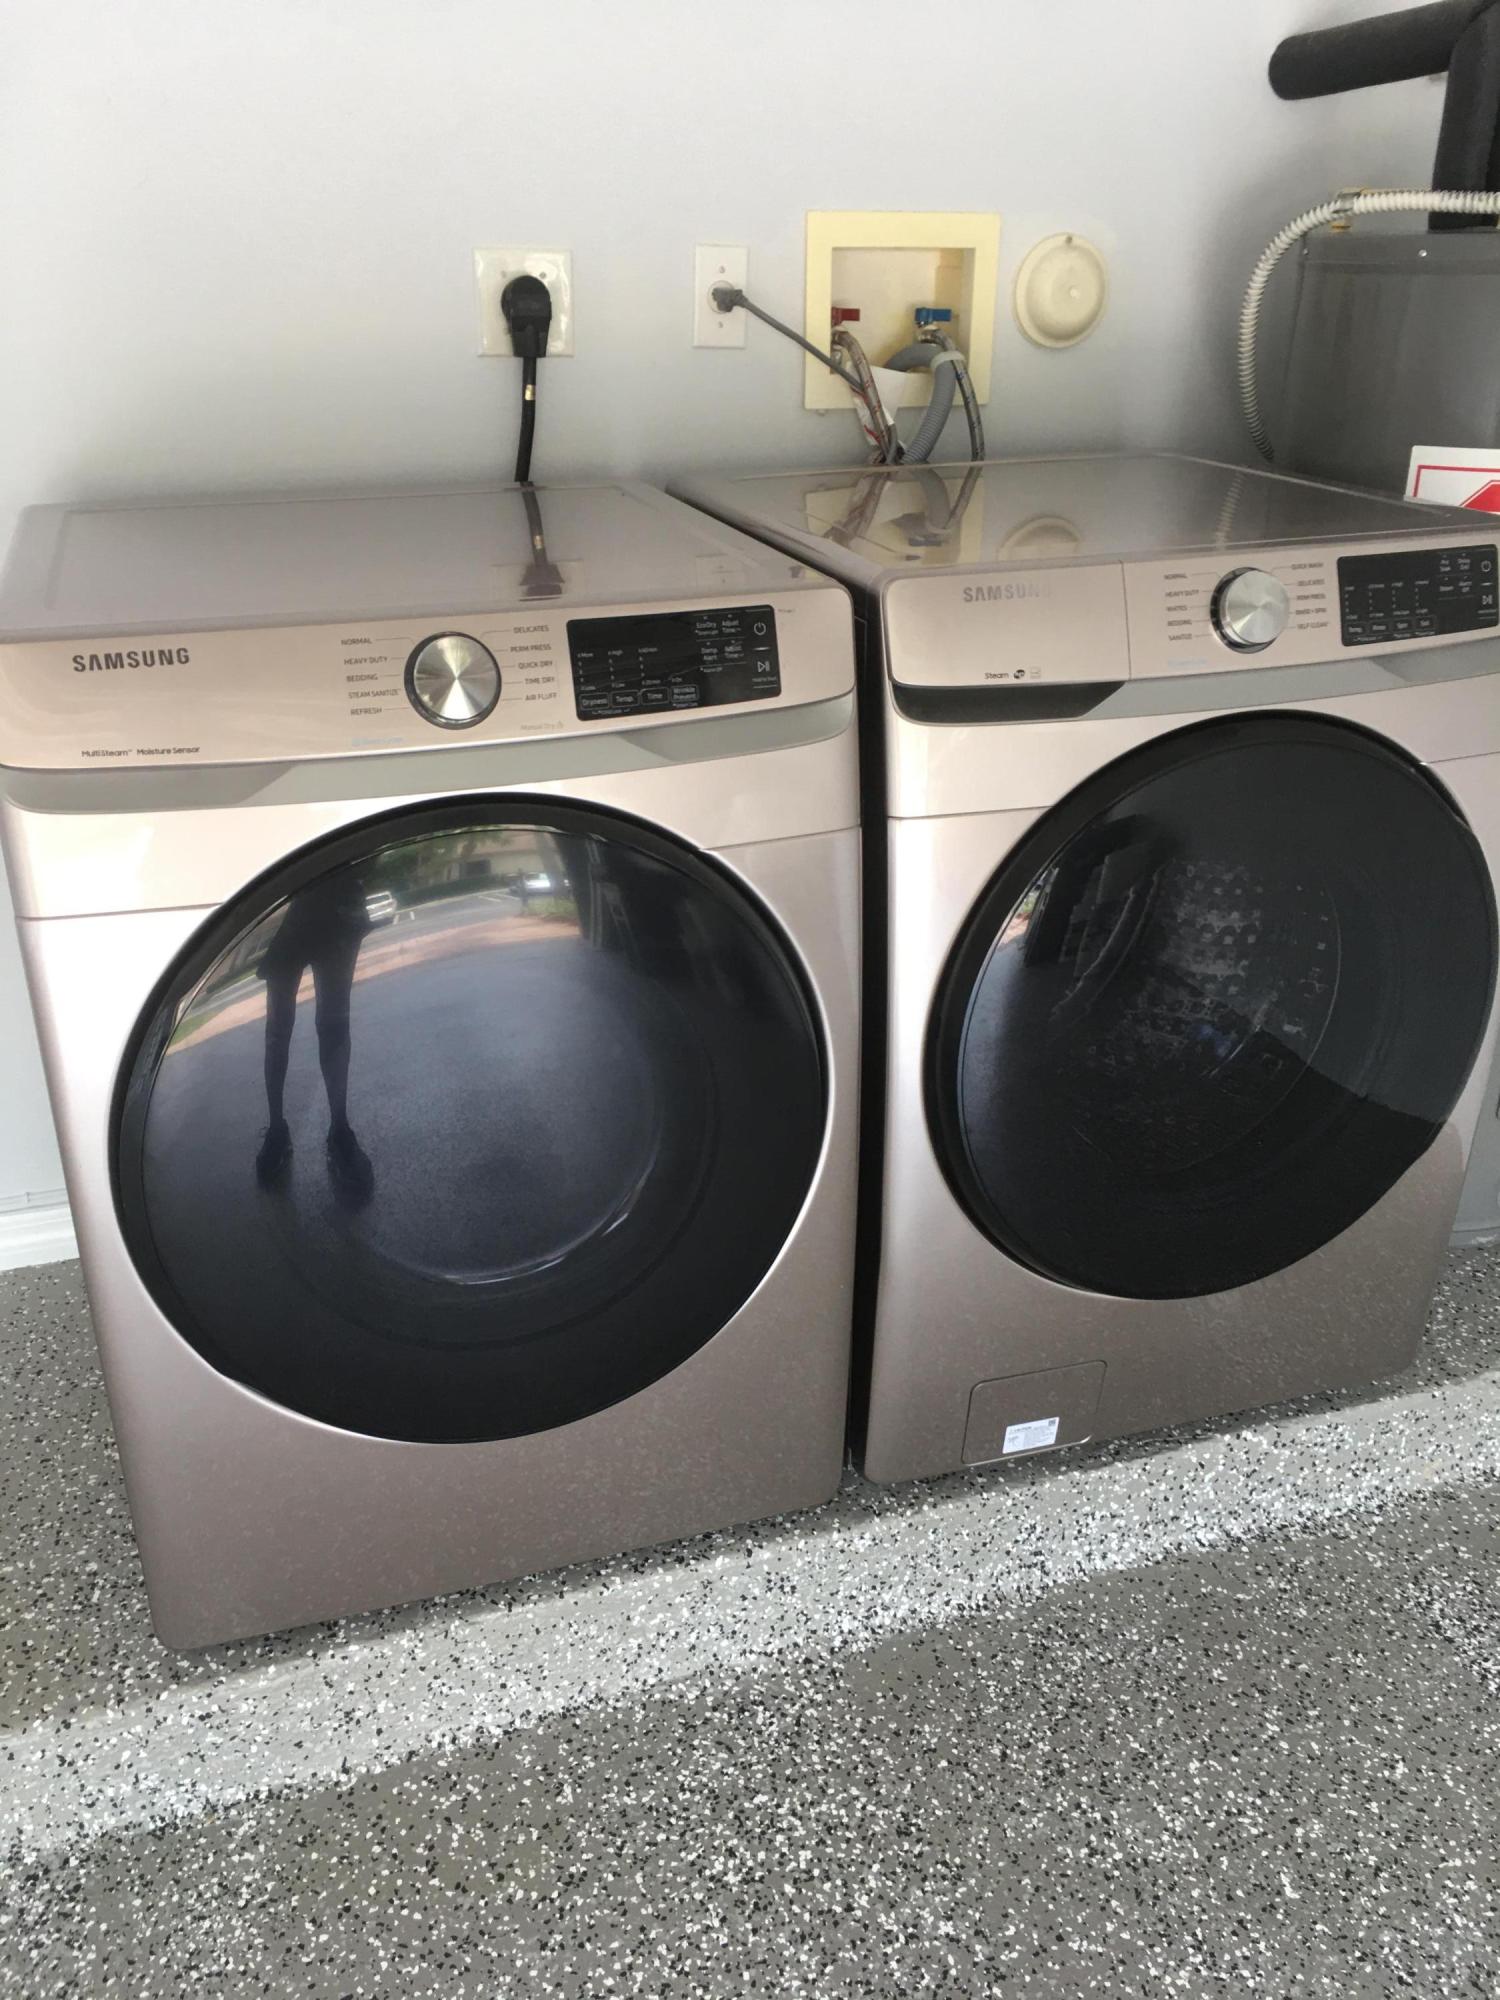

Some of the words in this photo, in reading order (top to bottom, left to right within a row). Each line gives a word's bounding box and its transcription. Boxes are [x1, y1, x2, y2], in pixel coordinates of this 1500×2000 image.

[513, 625, 549, 634] DELICATES
[341, 637, 372, 645] NORMAL
[530, 644, 551, 652] PRESS
[72, 647, 190, 672] SAMSUNG
[344, 657, 367, 665] HEAVY
[369, 656, 388, 664] DUTY
[518, 661, 538, 670] QUICK
[346, 674, 378, 682] BEDDING
[984, 671, 1009, 680] Steam
[348, 690, 371, 699] STEAM
[537, 692, 557, 700] FLUFF
[350, 707, 383, 715] REFRESH
[137, 747, 171, 756] Moisture
[172, 746, 200, 754] Sensor
